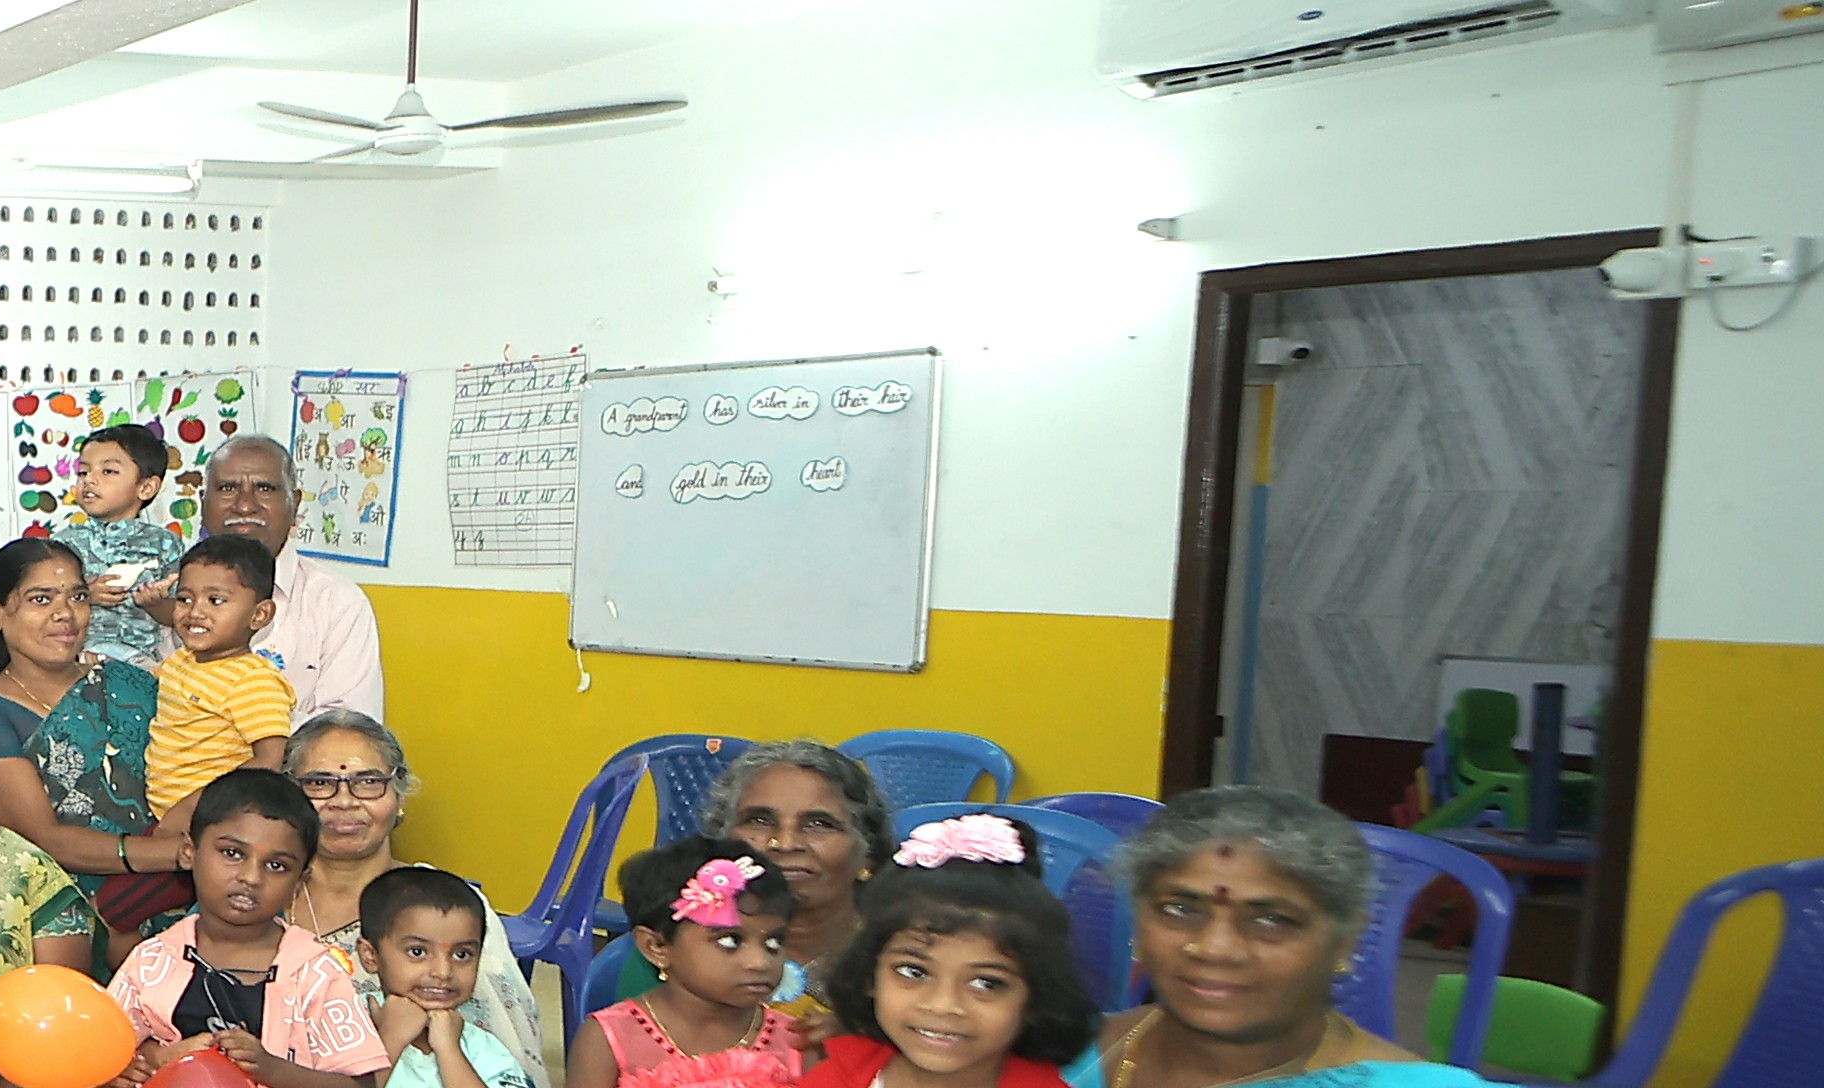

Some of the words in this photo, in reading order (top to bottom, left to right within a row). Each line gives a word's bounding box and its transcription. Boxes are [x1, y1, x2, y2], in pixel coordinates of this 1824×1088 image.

[752, 391, 788, 409] silver
[792, 395, 810, 409] in
[837, 389, 870, 408] their
[606, 407, 617, 423] A
[624, 402, 687, 433] grandparent
[708, 400, 735, 418] has
[805, 461, 842, 482] heart
[674, 467, 706, 503] gold
[711, 472, 728, 488] in
[734, 465, 769, 487] their
